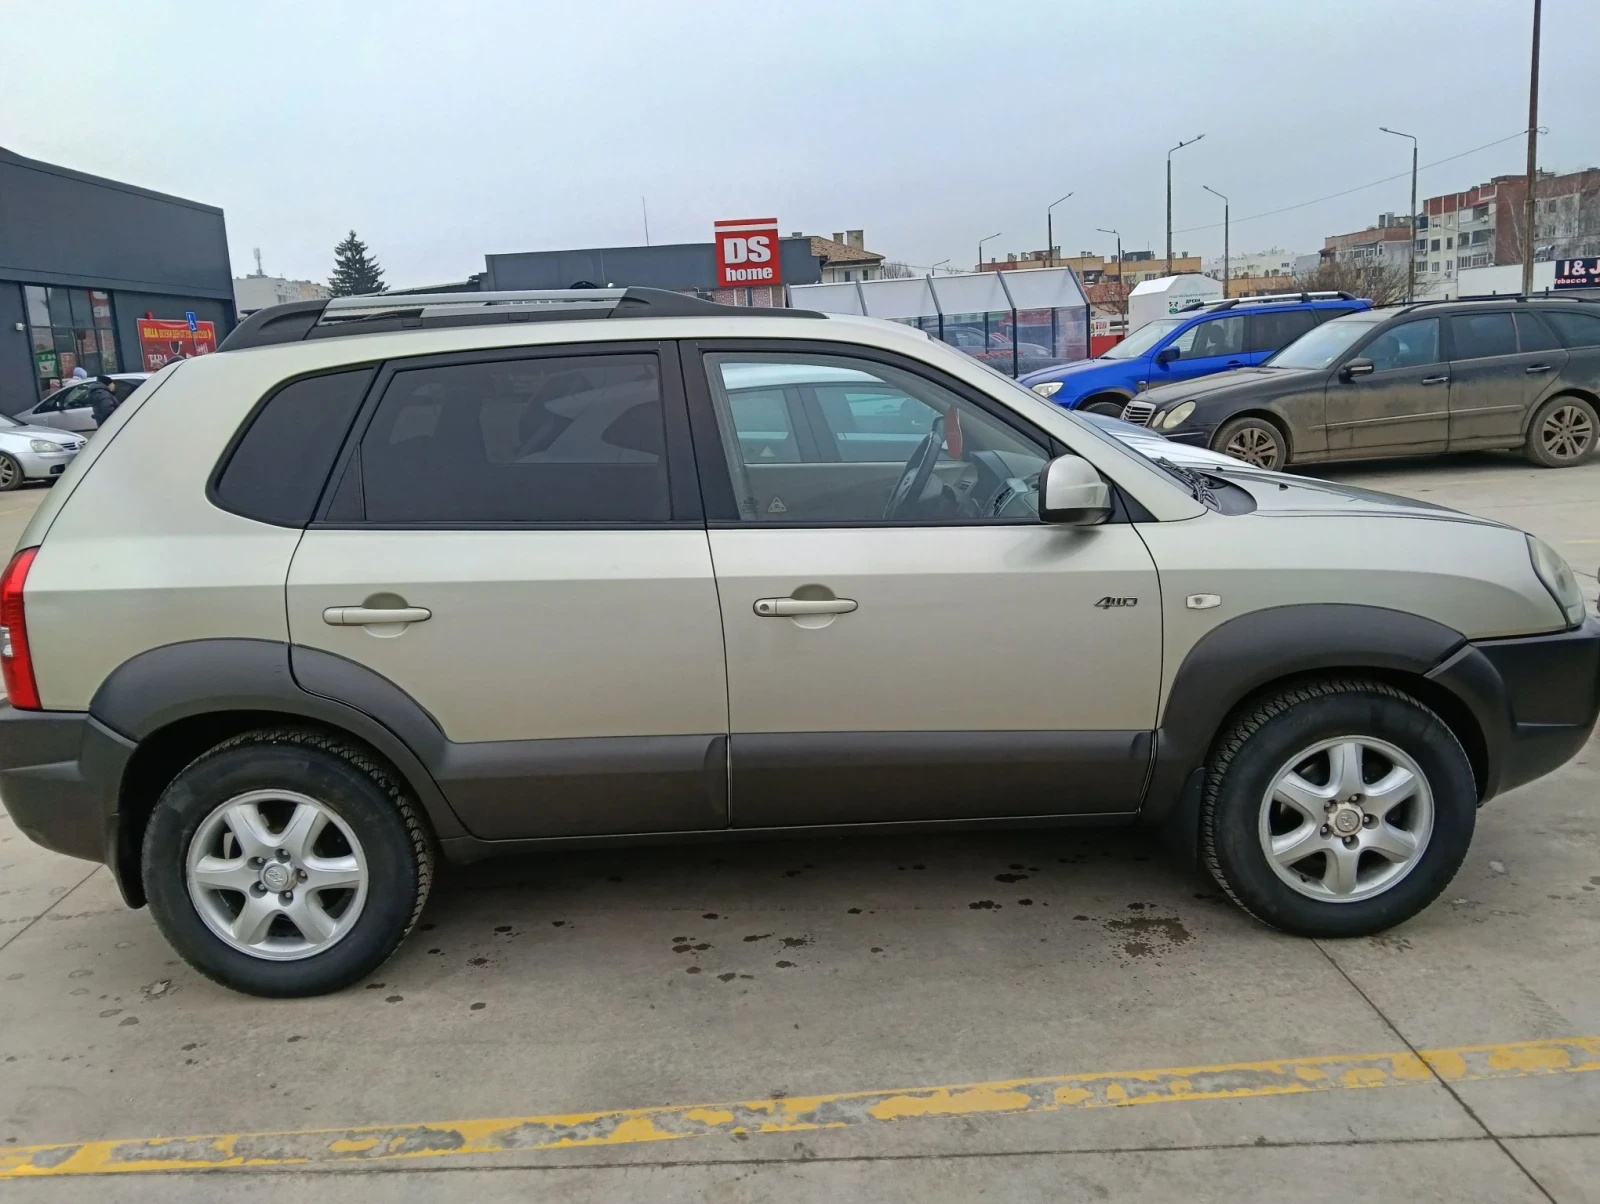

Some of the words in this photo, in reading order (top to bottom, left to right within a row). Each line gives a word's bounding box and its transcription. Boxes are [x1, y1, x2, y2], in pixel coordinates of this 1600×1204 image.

[723, 236, 771, 264] DS
[725, 267, 773, 282] home
[1571, 260, 1586, 275] &
[143, 328, 158, 338] BILLA
[1094, 596, 1138, 610] 4WD
